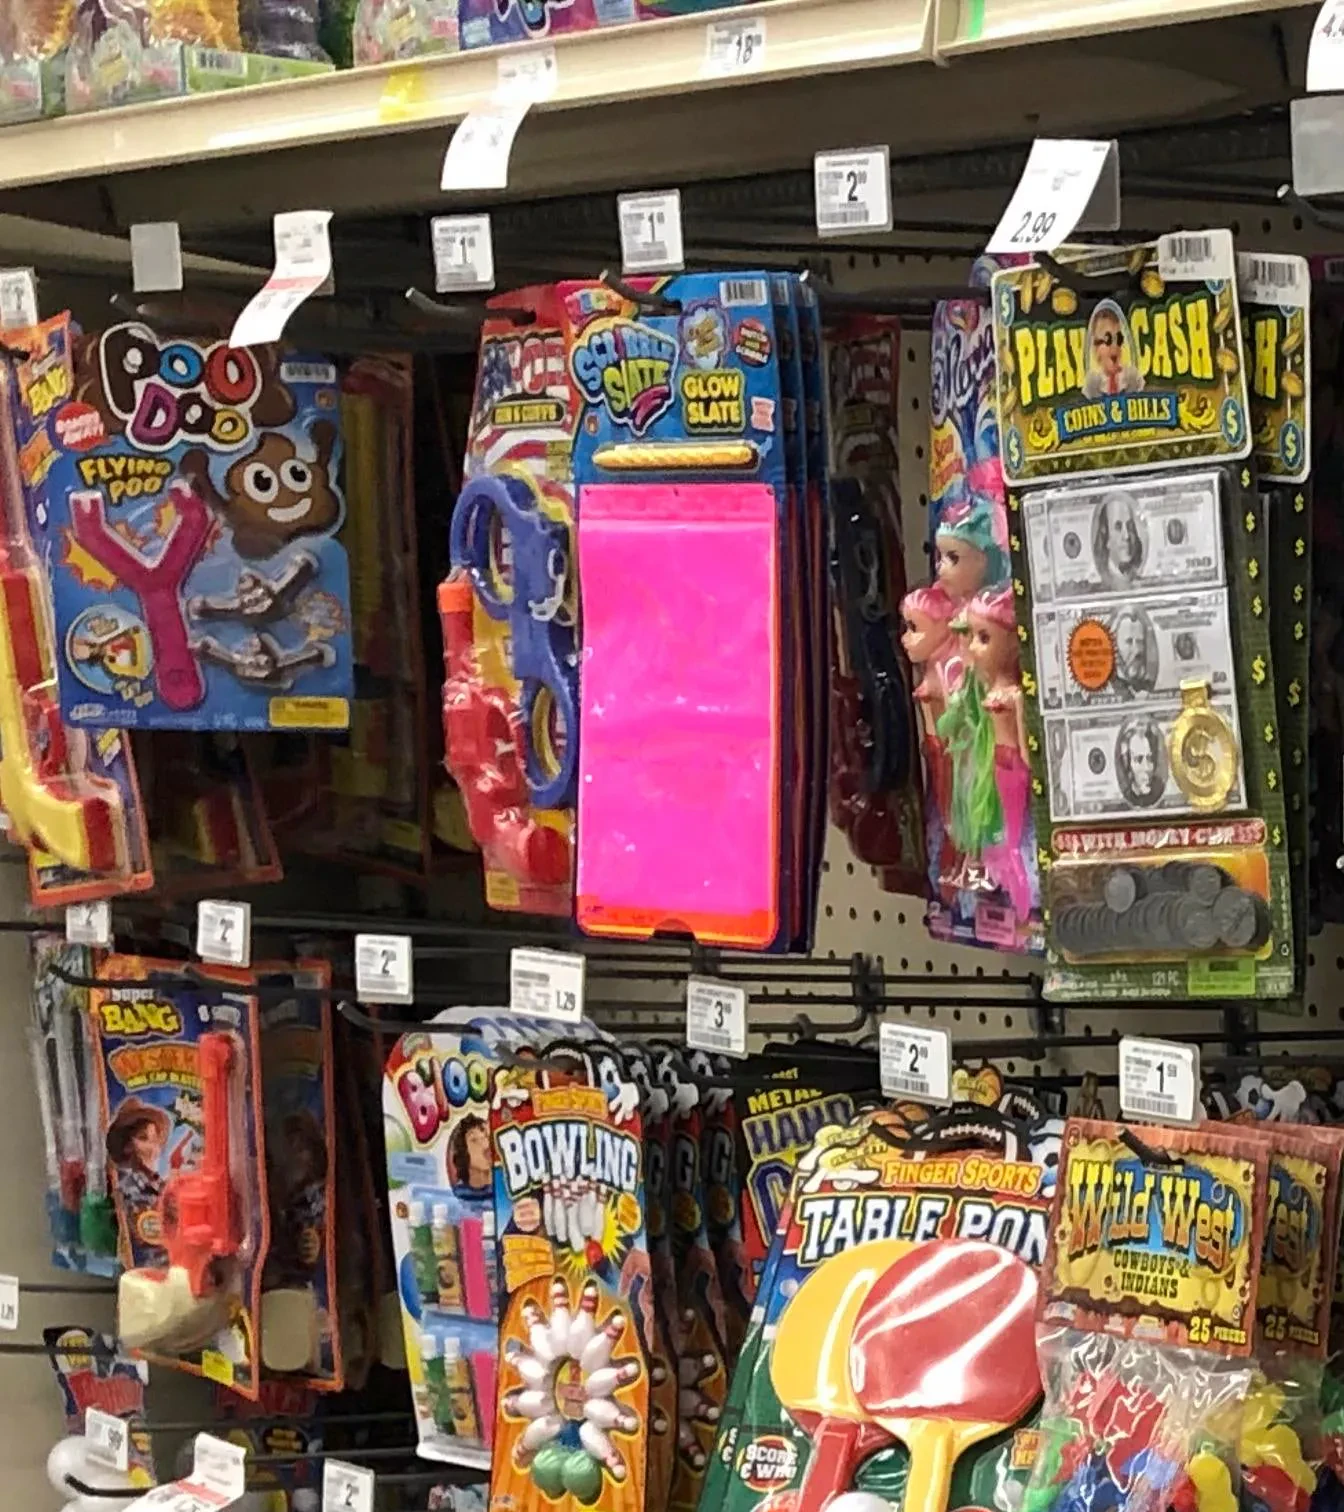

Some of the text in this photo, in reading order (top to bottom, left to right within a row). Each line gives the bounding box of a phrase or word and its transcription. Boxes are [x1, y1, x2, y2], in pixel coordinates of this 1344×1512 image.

[1009, 211, 1057, 244] 2.99
[1014, 299, 1214, 406] PLAY CASH
[684, 373, 740, 398] GLOW
[688, 399, 741, 424] SLATE
[1064, 398, 1170, 433] COINS & BILLS
[79, 456, 173, 485] FLYING
[109, 477, 163, 503] POO
[101, 1004, 179, 1034] BANG
[499, 1122, 639, 1191] BOWLING
[885, 1159, 1041, 1193] FINGER SPORTS
[802, 1197, 945, 1263] TABLE
[1070, 1160, 1235, 1271] Wild West
[1114, 1250, 1175, 1273] COWBOYS
[1122, 1272, 1178, 1298] INDIANS
[1189, 1316, 1210, 1343] 25
[746, 1444, 798, 1464] SCORE
